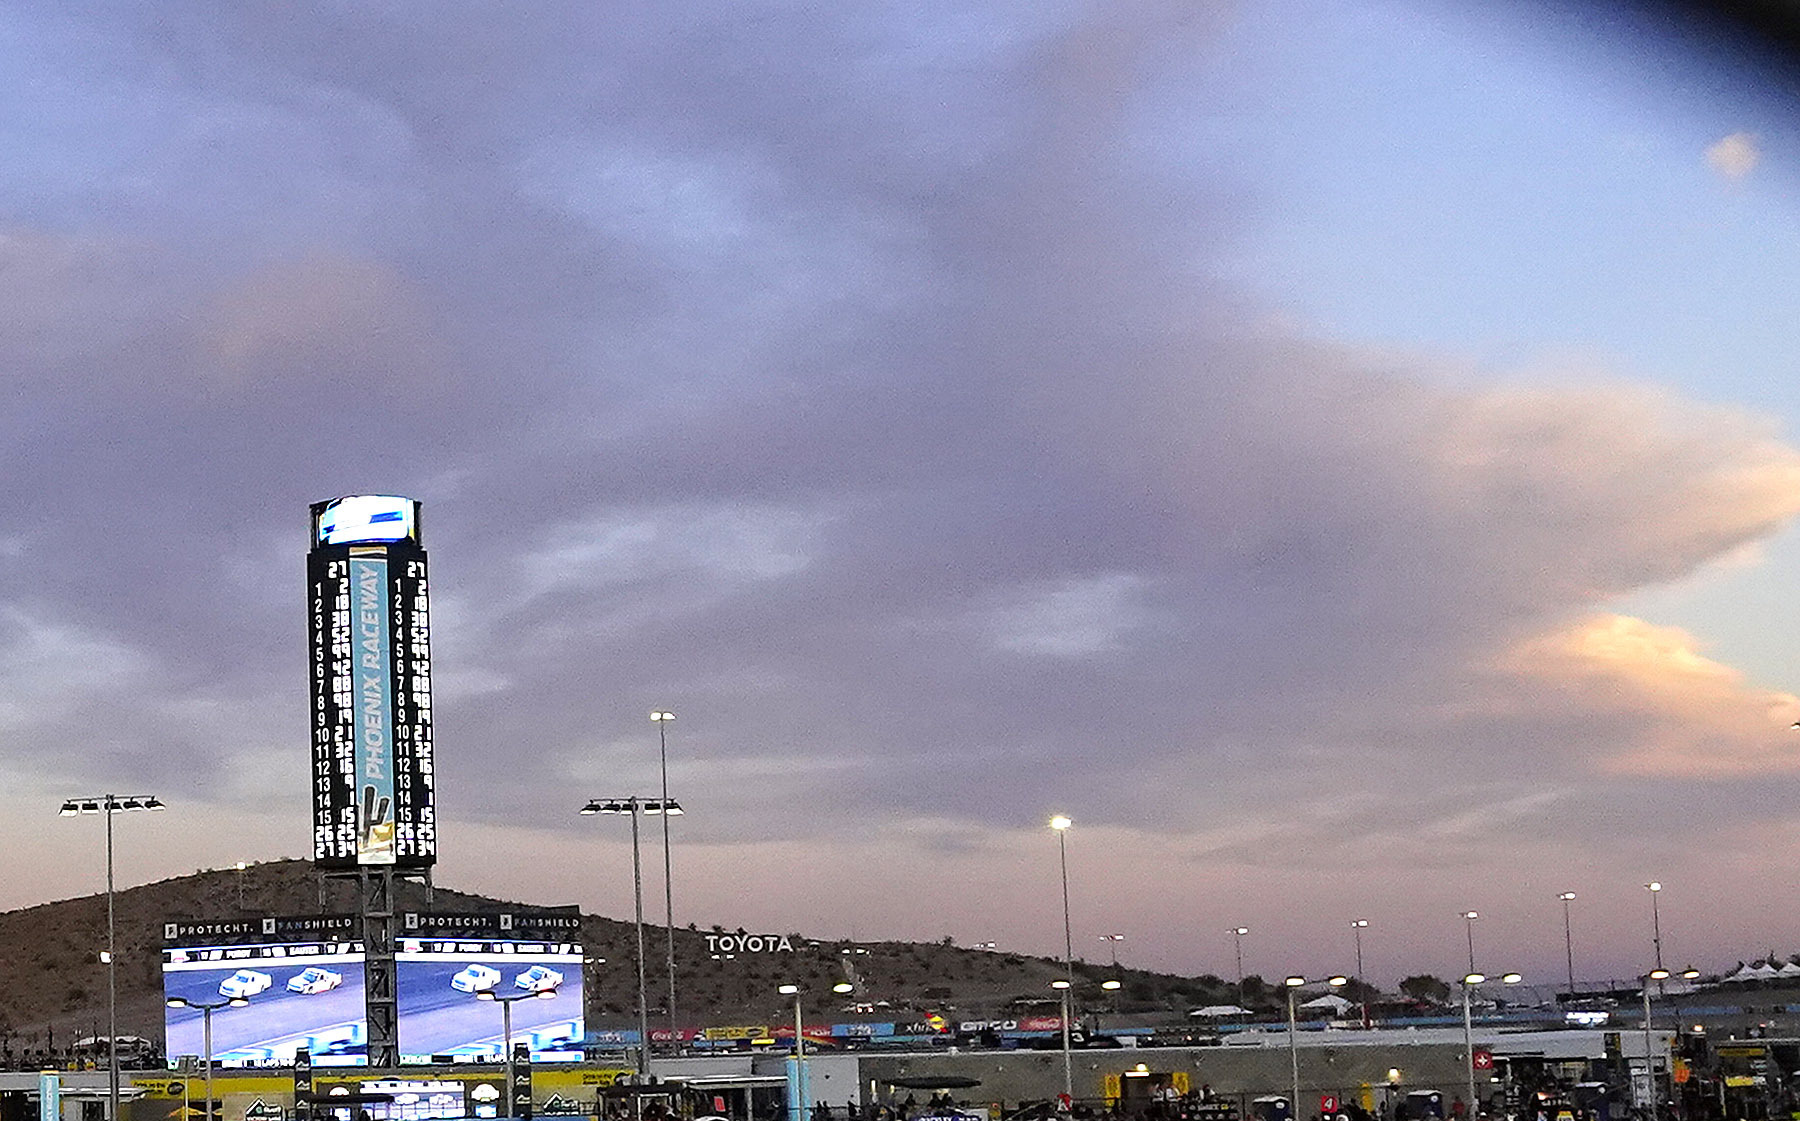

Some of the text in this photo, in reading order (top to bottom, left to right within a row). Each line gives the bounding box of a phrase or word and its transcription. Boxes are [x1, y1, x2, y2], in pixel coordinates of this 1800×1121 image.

[329, 561, 346, 578] 27
[408, 562, 424, 577] 27
[340, 578, 348, 593] 2
[418, 580, 426, 595] 2
[314, 595, 349, 612] 2 18
[394, 594, 427, 611] 2 18
[315, 611, 349, 629] 3 38
[395, 611, 427, 627] 3 38
[315, 627, 349, 644] 4 52
[395, 627, 428, 644] 4 52
[316, 644, 350, 661] 5 99
[396, 644, 428, 659] 5 99
[316, 660, 350, 677] 6 42
[359, 564, 384, 779] PHOENIX RACEWAY
[396, 660, 429, 676] 6 42
[316, 676, 351, 693] 7 88
[397, 676, 429, 692] 7 88
[317, 693, 351, 710] 8 98
[397, 692, 430, 708] 8 98
[317, 709, 352, 726] 9 19
[398, 709, 430, 724] 9 19
[315, 726, 352, 742] 10 21
[396, 725, 431, 740] 10 21
[315, 742, 353, 759] 11 32
[396, 742, 431, 757] 11 32
[316, 759, 353, 775] 12 16
[397, 758, 432, 774] 12 16
[316, 775, 354, 791] 13 9
[397, 774, 432, 789] 13 9
[316, 793, 331, 808] 14
[398, 791, 411, 804] 14
[317, 808, 355, 824] 15 15
[398, 807, 433, 823] 15 15
[315, 824, 355, 841] 26 25
[397, 823, 434, 840] 26 25
[315, 841, 355, 858] 27 34
[397, 840, 434, 856] 27 34
[705, 935, 793, 952] TOYOTA
